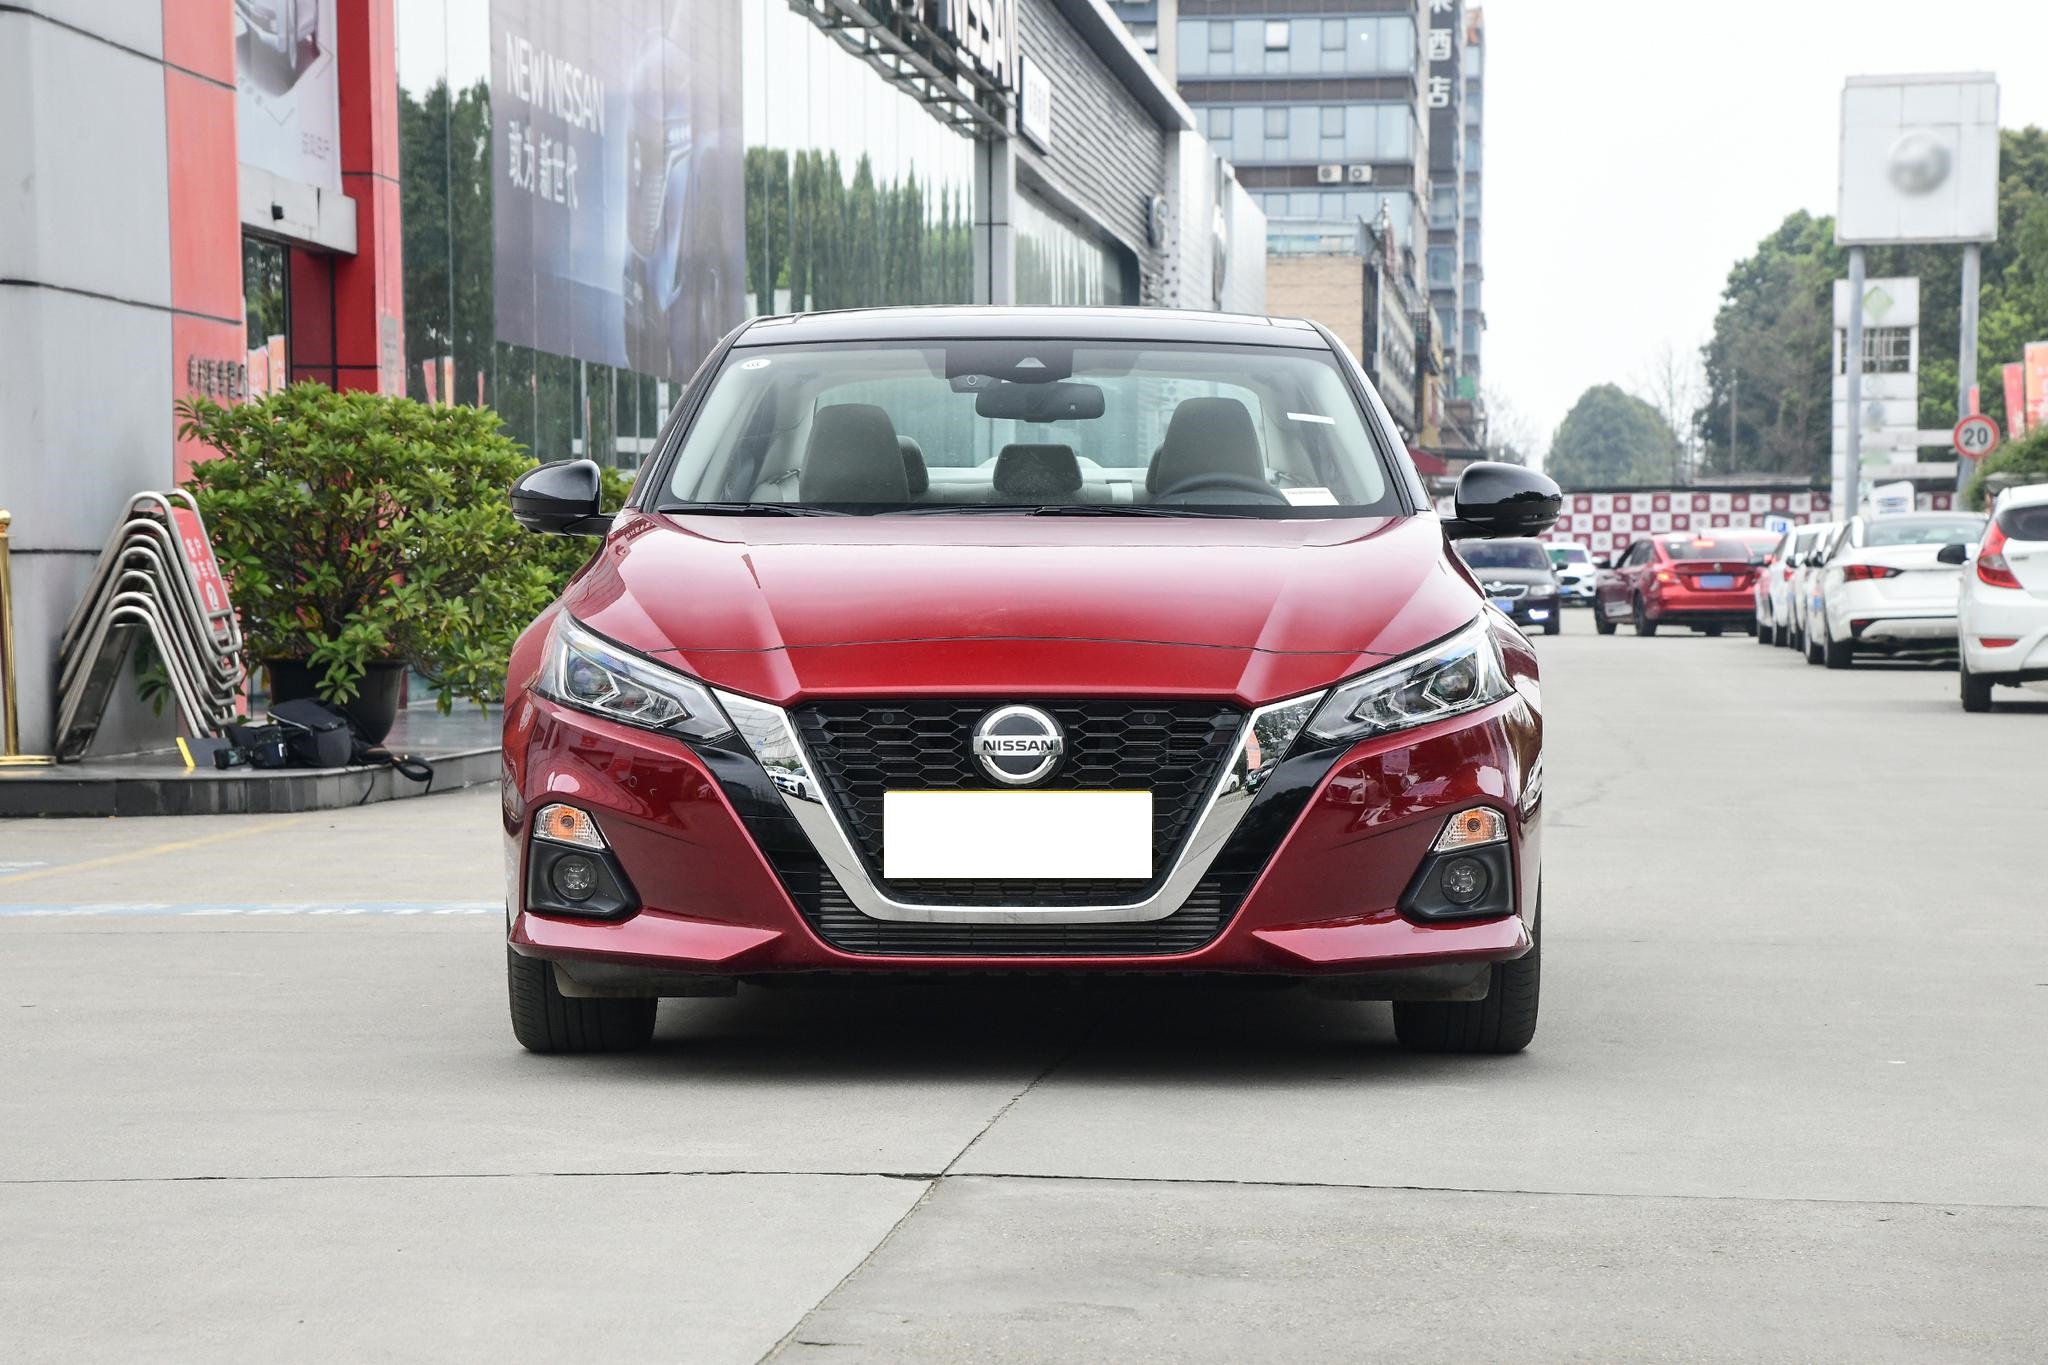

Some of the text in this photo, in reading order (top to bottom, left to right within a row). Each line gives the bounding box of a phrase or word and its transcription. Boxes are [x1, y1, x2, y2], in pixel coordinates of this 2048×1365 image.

[506, 32, 605, 137] NEW NISSAN
[1963, 427, 1988, 446] 20
[983, 740, 1054, 751] NISSAN
